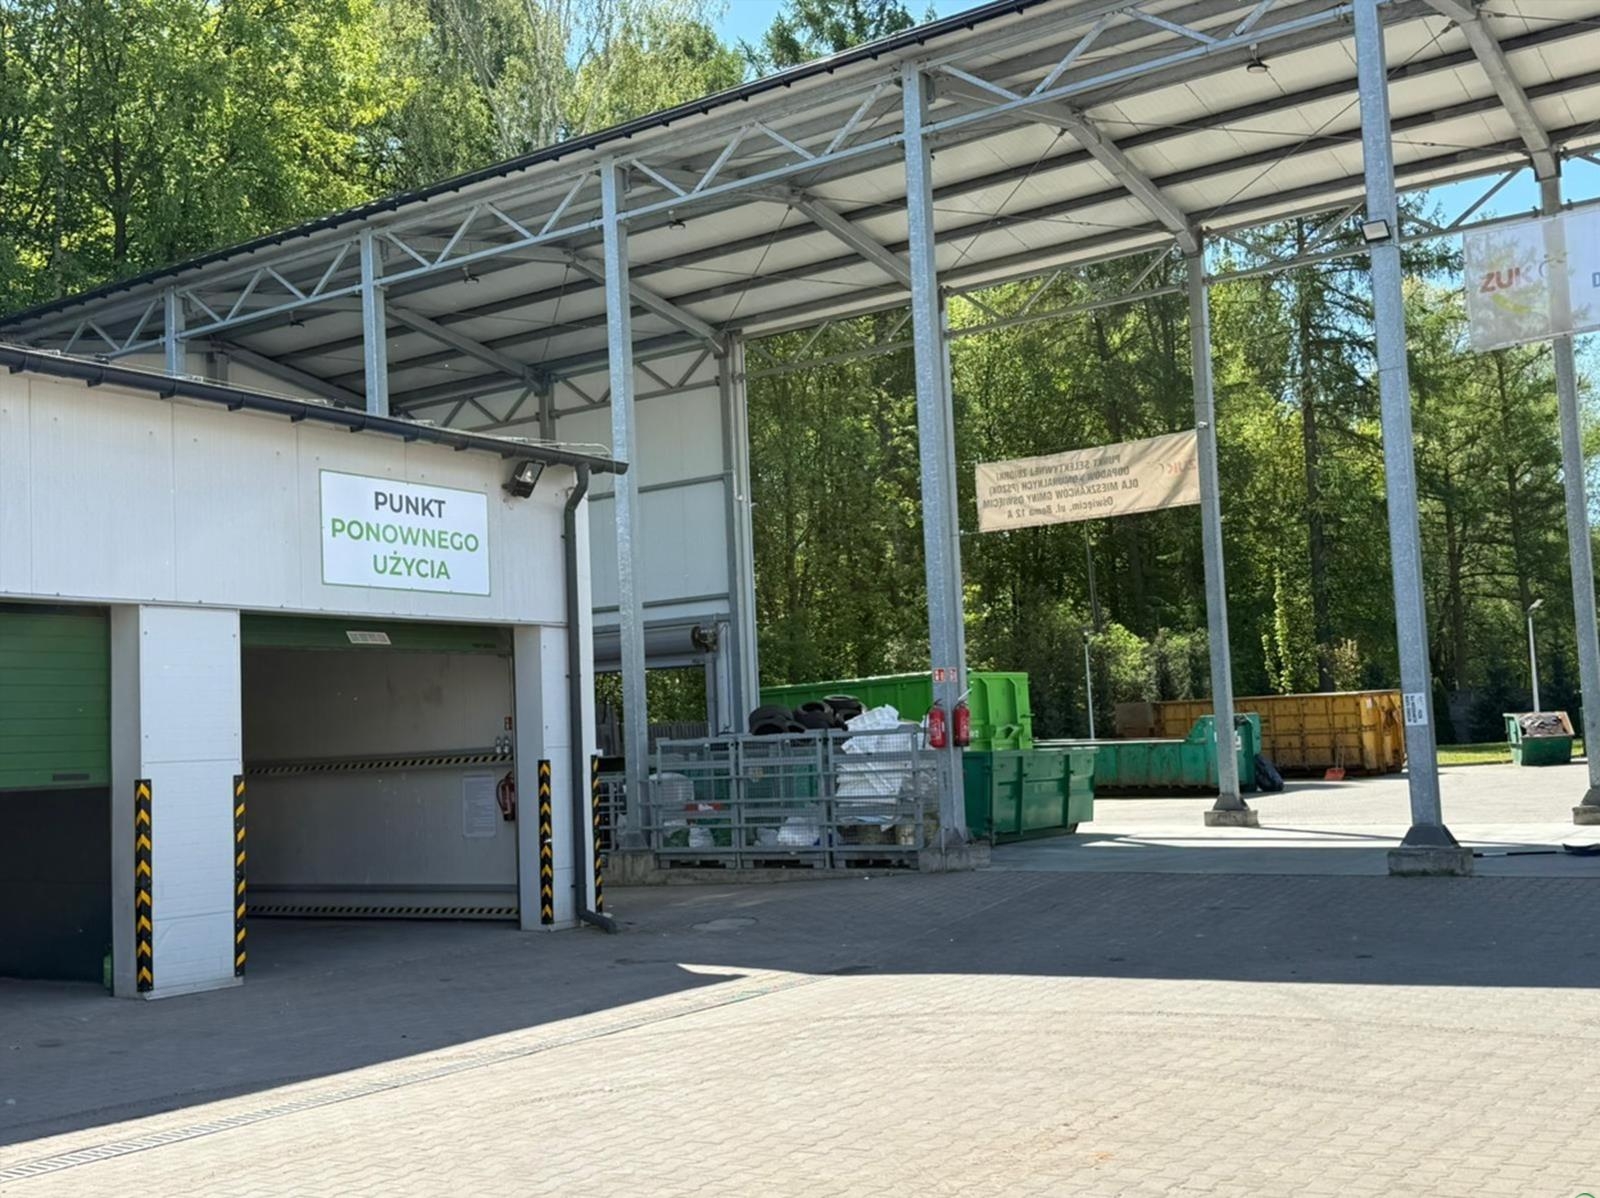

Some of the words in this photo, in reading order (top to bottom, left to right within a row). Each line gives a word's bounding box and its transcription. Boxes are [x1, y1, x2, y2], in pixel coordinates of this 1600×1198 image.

[374, 491, 446, 518] PUNKT
[331, 518, 479, 553] PONOWNEGO
[373, 550, 451, 580] UŻYCIA
